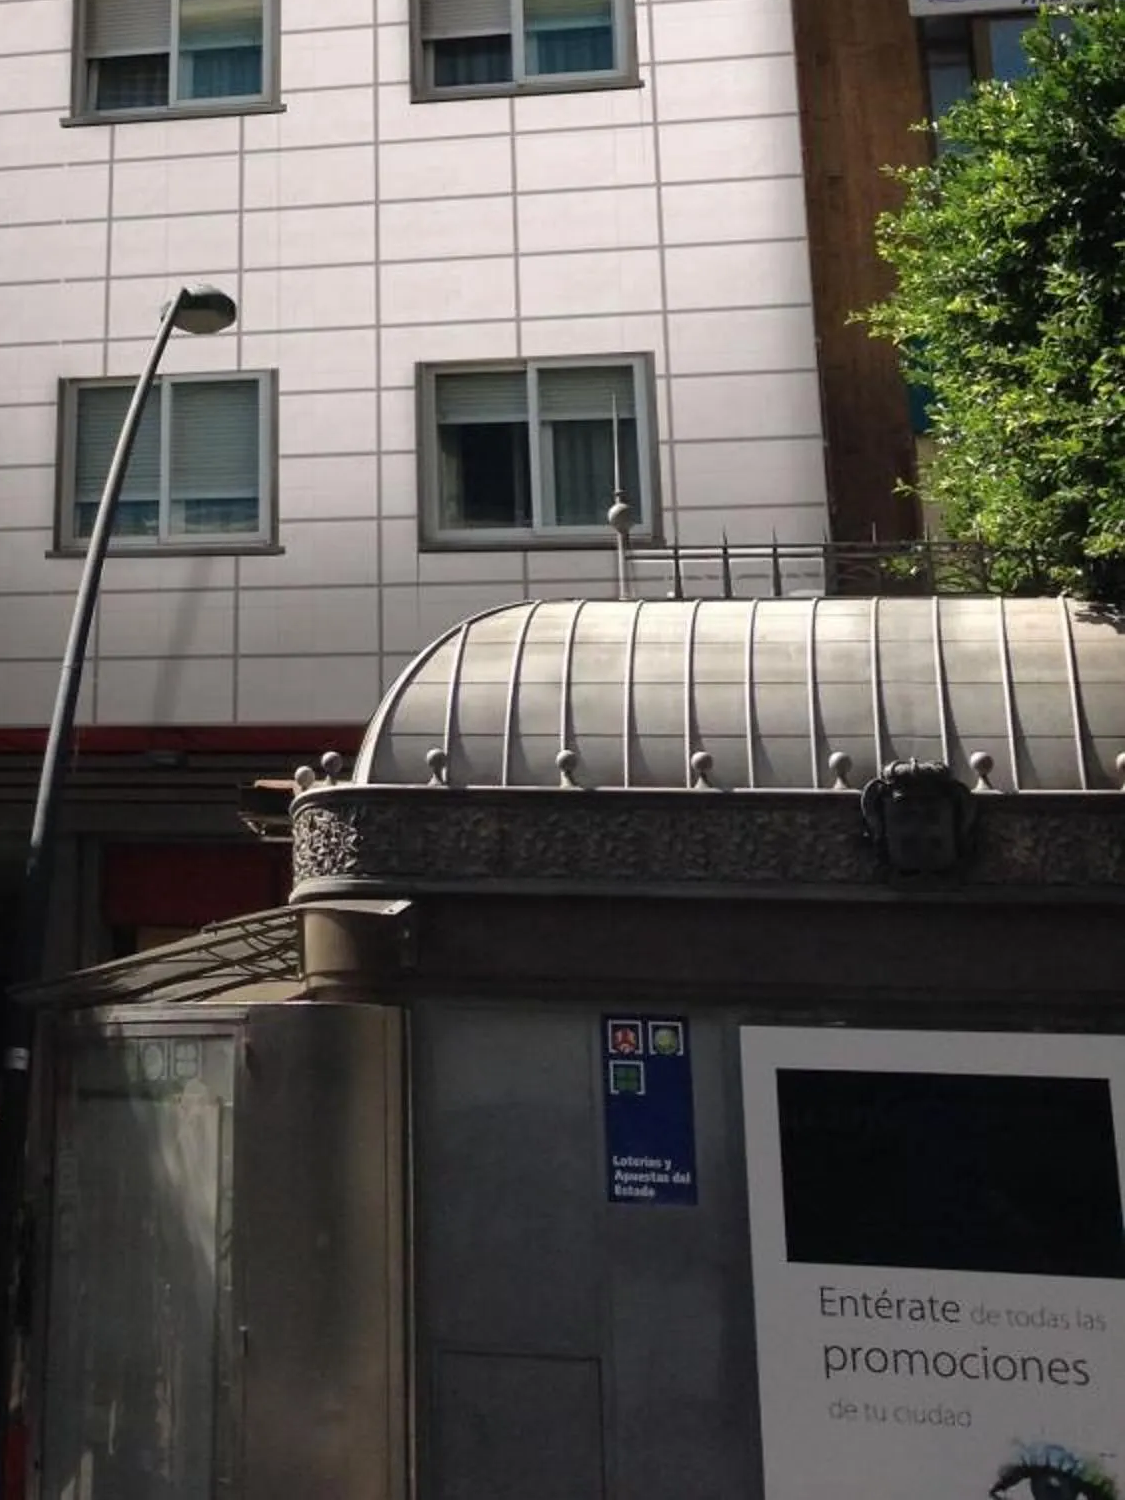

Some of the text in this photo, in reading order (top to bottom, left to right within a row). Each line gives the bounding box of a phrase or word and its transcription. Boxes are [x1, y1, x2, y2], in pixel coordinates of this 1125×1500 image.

[664, 1158, 672, 1170] y
[614, 1170, 691, 1184] Apuestas del
[614, 1183, 655, 1197] Estado
[819, 1285, 1108, 1331] Entérate de todas las
[823, 1343, 1092, 1387] promociones
[828, 1397, 973, 1428] de tu ciudad
